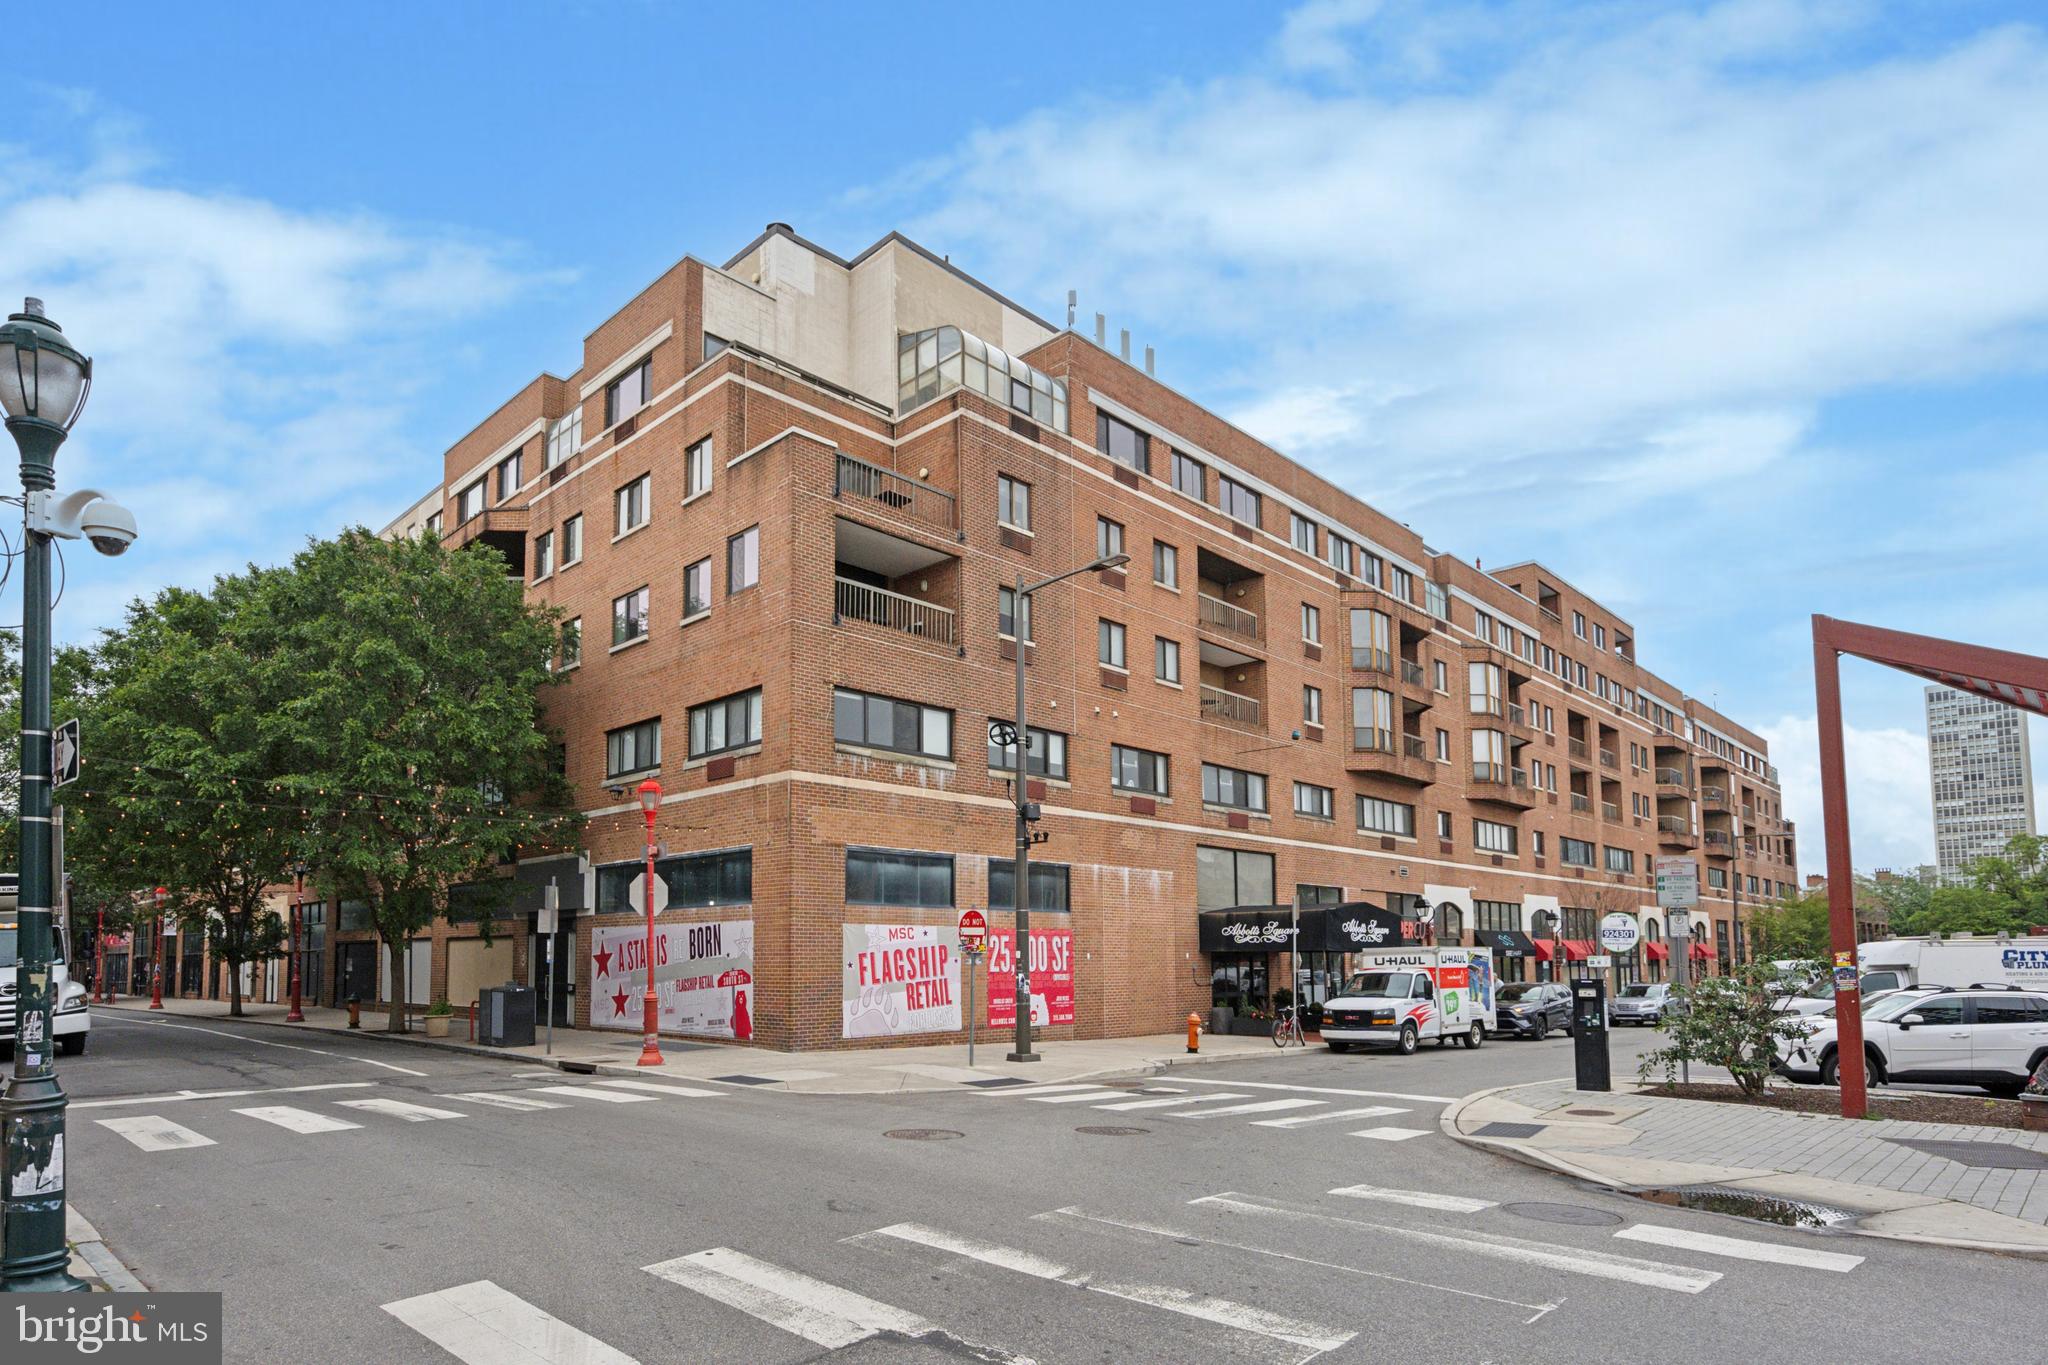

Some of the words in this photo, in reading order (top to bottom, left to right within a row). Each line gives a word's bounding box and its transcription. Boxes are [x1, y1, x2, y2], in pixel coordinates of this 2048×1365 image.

[889, 928, 914, 941] MSC
[1263, 921, 1300, 936] Square
[619, 943, 625, 972] A
[627, 938, 649, 971] STA
[657, 934, 667, 966] IS
[689, 924, 722, 960] BORN
[989, 935, 1048, 976] 25,00
[1052, 936, 1070, 972] SF
[2003, 949, 2048, 961] CITY
[858, 944, 948, 987] FLAGSHIP
[675, 976, 697, 993] FLAGSHIP
[699, 975, 714, 990] RETAIL
[905, 978, 953, 1011] RETAIL
